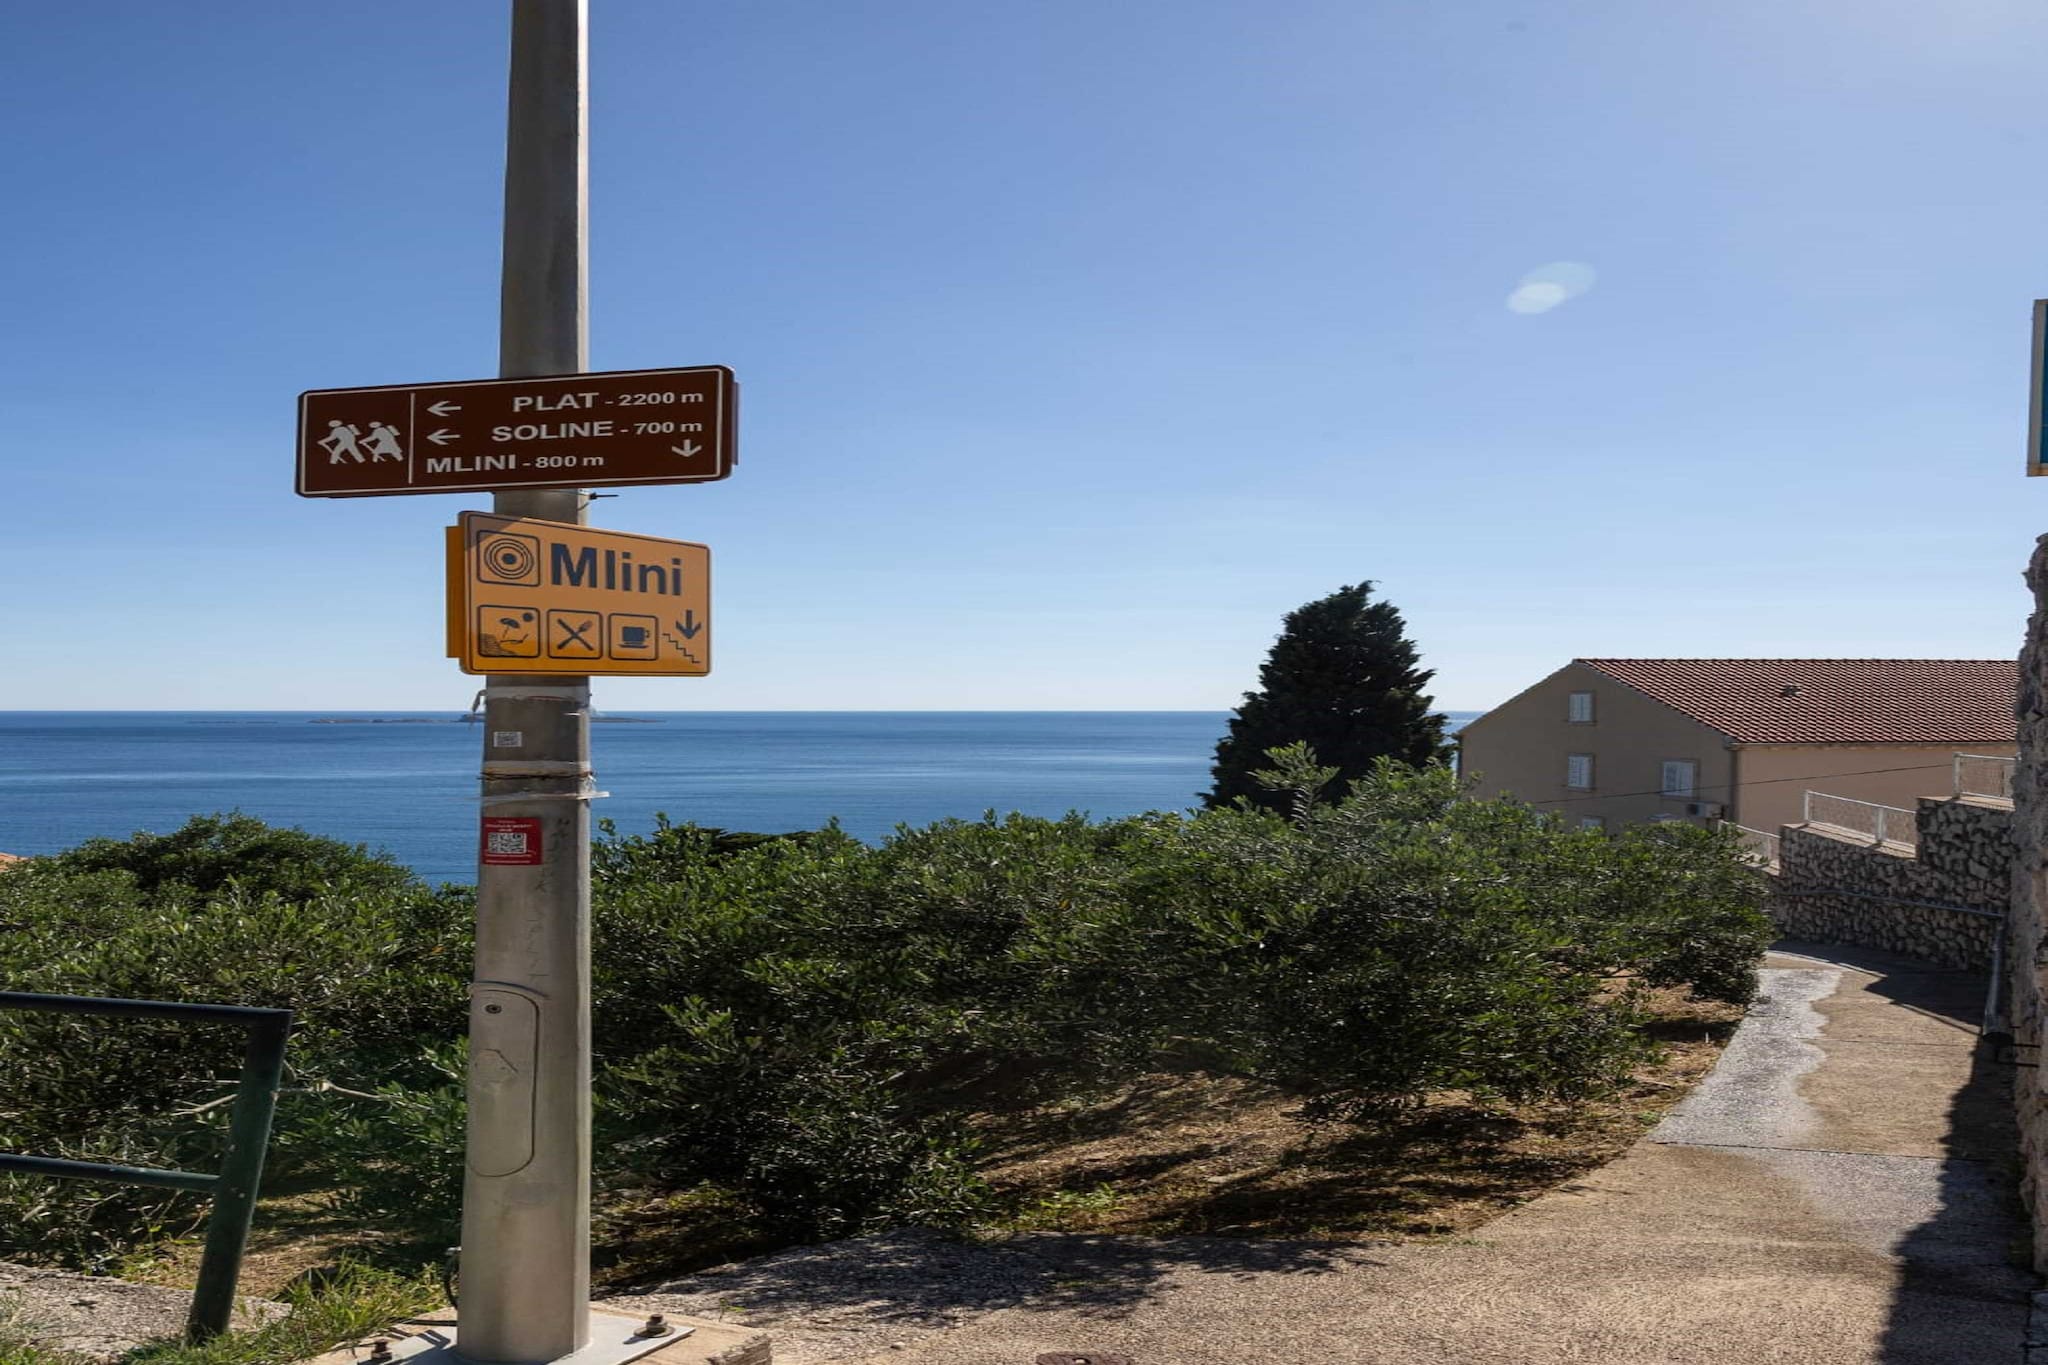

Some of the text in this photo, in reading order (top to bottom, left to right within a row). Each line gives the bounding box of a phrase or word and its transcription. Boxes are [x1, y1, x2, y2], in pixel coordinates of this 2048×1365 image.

[512, 392, 600, 413] PLAT
[619, 391, 675, 407] 2200
[681, 392, 704, 404] m
[491, 420, 614, 442] SOLINE
[634, 421, 675, 435] 700
[680, 422, 703, 433] m
[426, 454, 517, 474] MLINI
[535, 455, 578, 469] 800
[583, 456, 605, 467] m
[550, 542, 683, 597] Mlini
